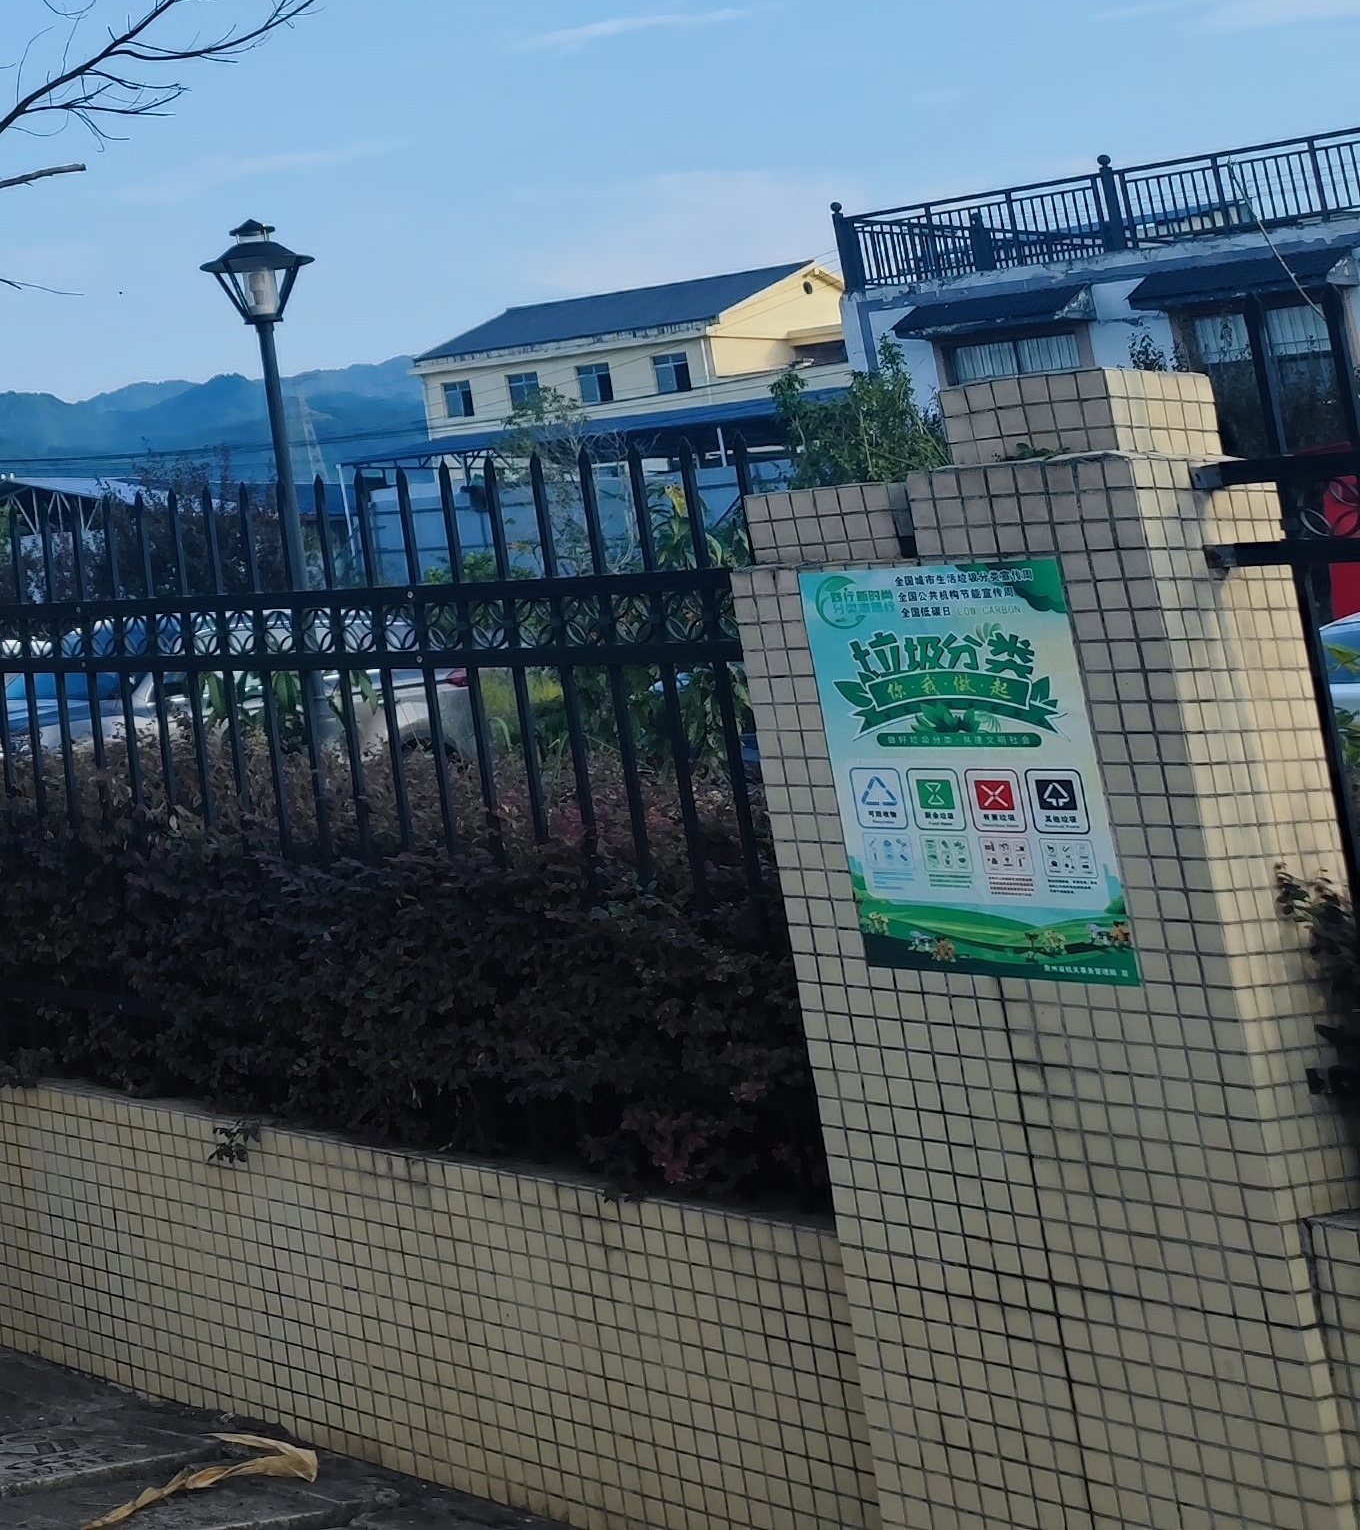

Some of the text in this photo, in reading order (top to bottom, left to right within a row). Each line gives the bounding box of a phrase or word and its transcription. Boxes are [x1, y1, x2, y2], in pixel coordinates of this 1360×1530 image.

[894, 568, 1034, 587] 全国城市生活垃圾分类宣传周
[897, 586, 1014, 603] 全国公共机构节能宣传周
[900, 605, 1021, 619] 全国低碳日 LOW CARBON
[848, 631, 1035, 679] 垃圾分类
